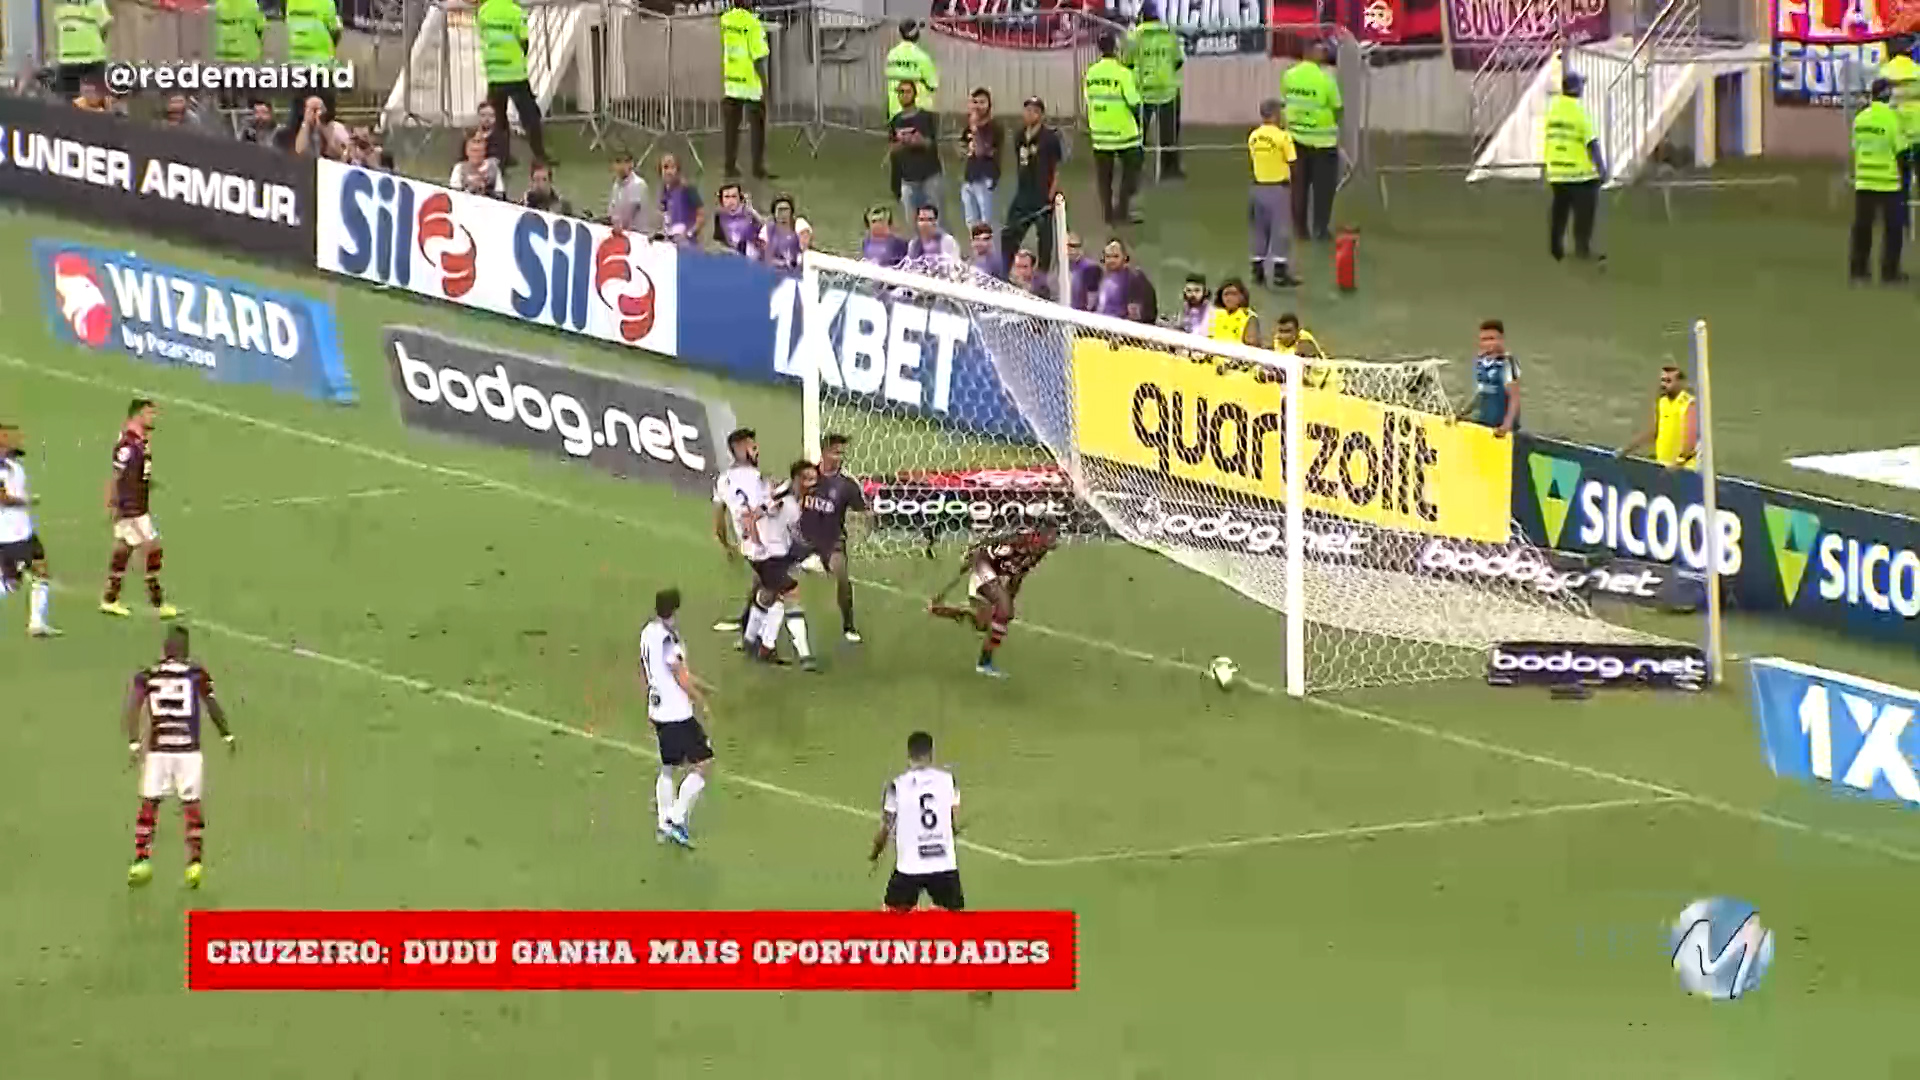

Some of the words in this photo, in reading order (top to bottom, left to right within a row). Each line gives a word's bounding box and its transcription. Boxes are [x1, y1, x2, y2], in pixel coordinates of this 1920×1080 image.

[12, 129, 132, 191] UNDER
[140, 158, 299, 227] ARMOUR
[338, 166, 415, 286] Sil
[104, 262, 299, 361] WIZARD
[511, 210, 592, 333] Sil
[121, 323, 144, 356] by
[769, 276, 970, 414] 1XBET
[394, 340, 706, 472] bodog.net
[1131, 381, 1438, 523] quarzolit
[1580, 480, 1742, 576] SICOOB
[1492, 648, 1706, 680] bodog.net
[918, 791, 938, 831] 6
